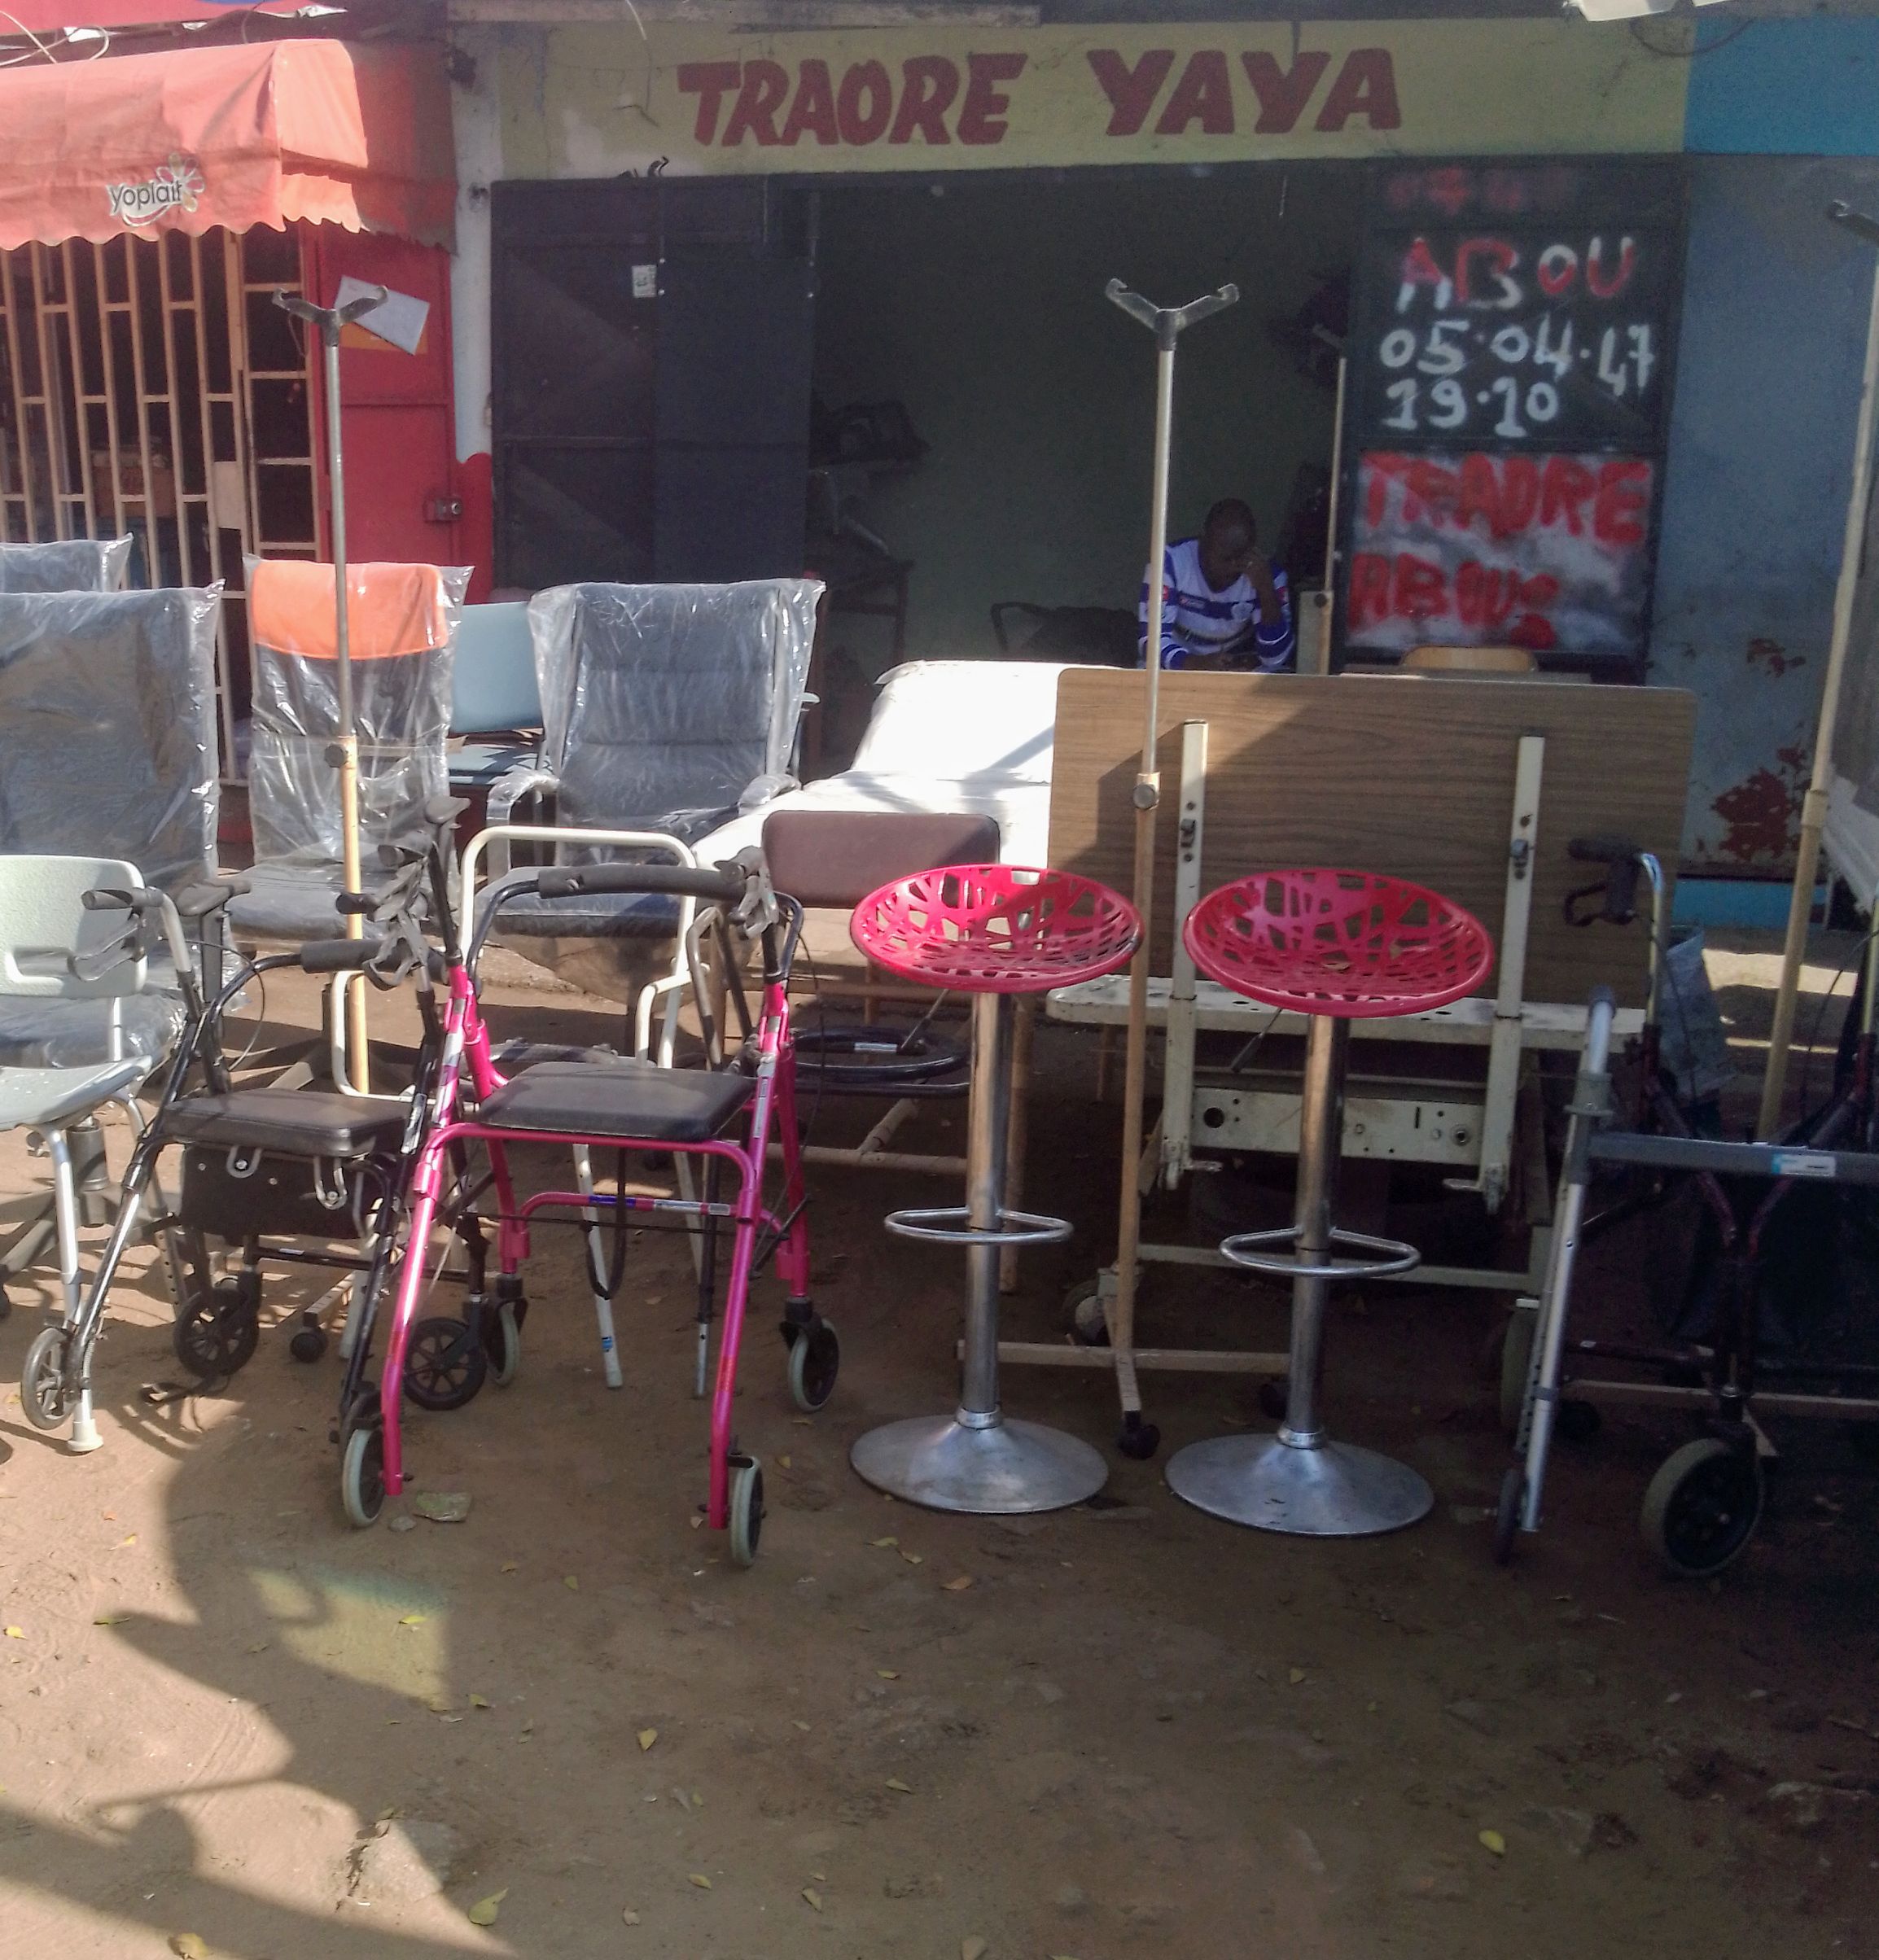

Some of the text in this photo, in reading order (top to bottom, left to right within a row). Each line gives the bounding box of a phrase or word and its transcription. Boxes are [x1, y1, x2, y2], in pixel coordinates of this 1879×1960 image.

[677, 48, 1402, 147] TRAORE YAYA
[1395, 235, 1638, 314] ABOU
